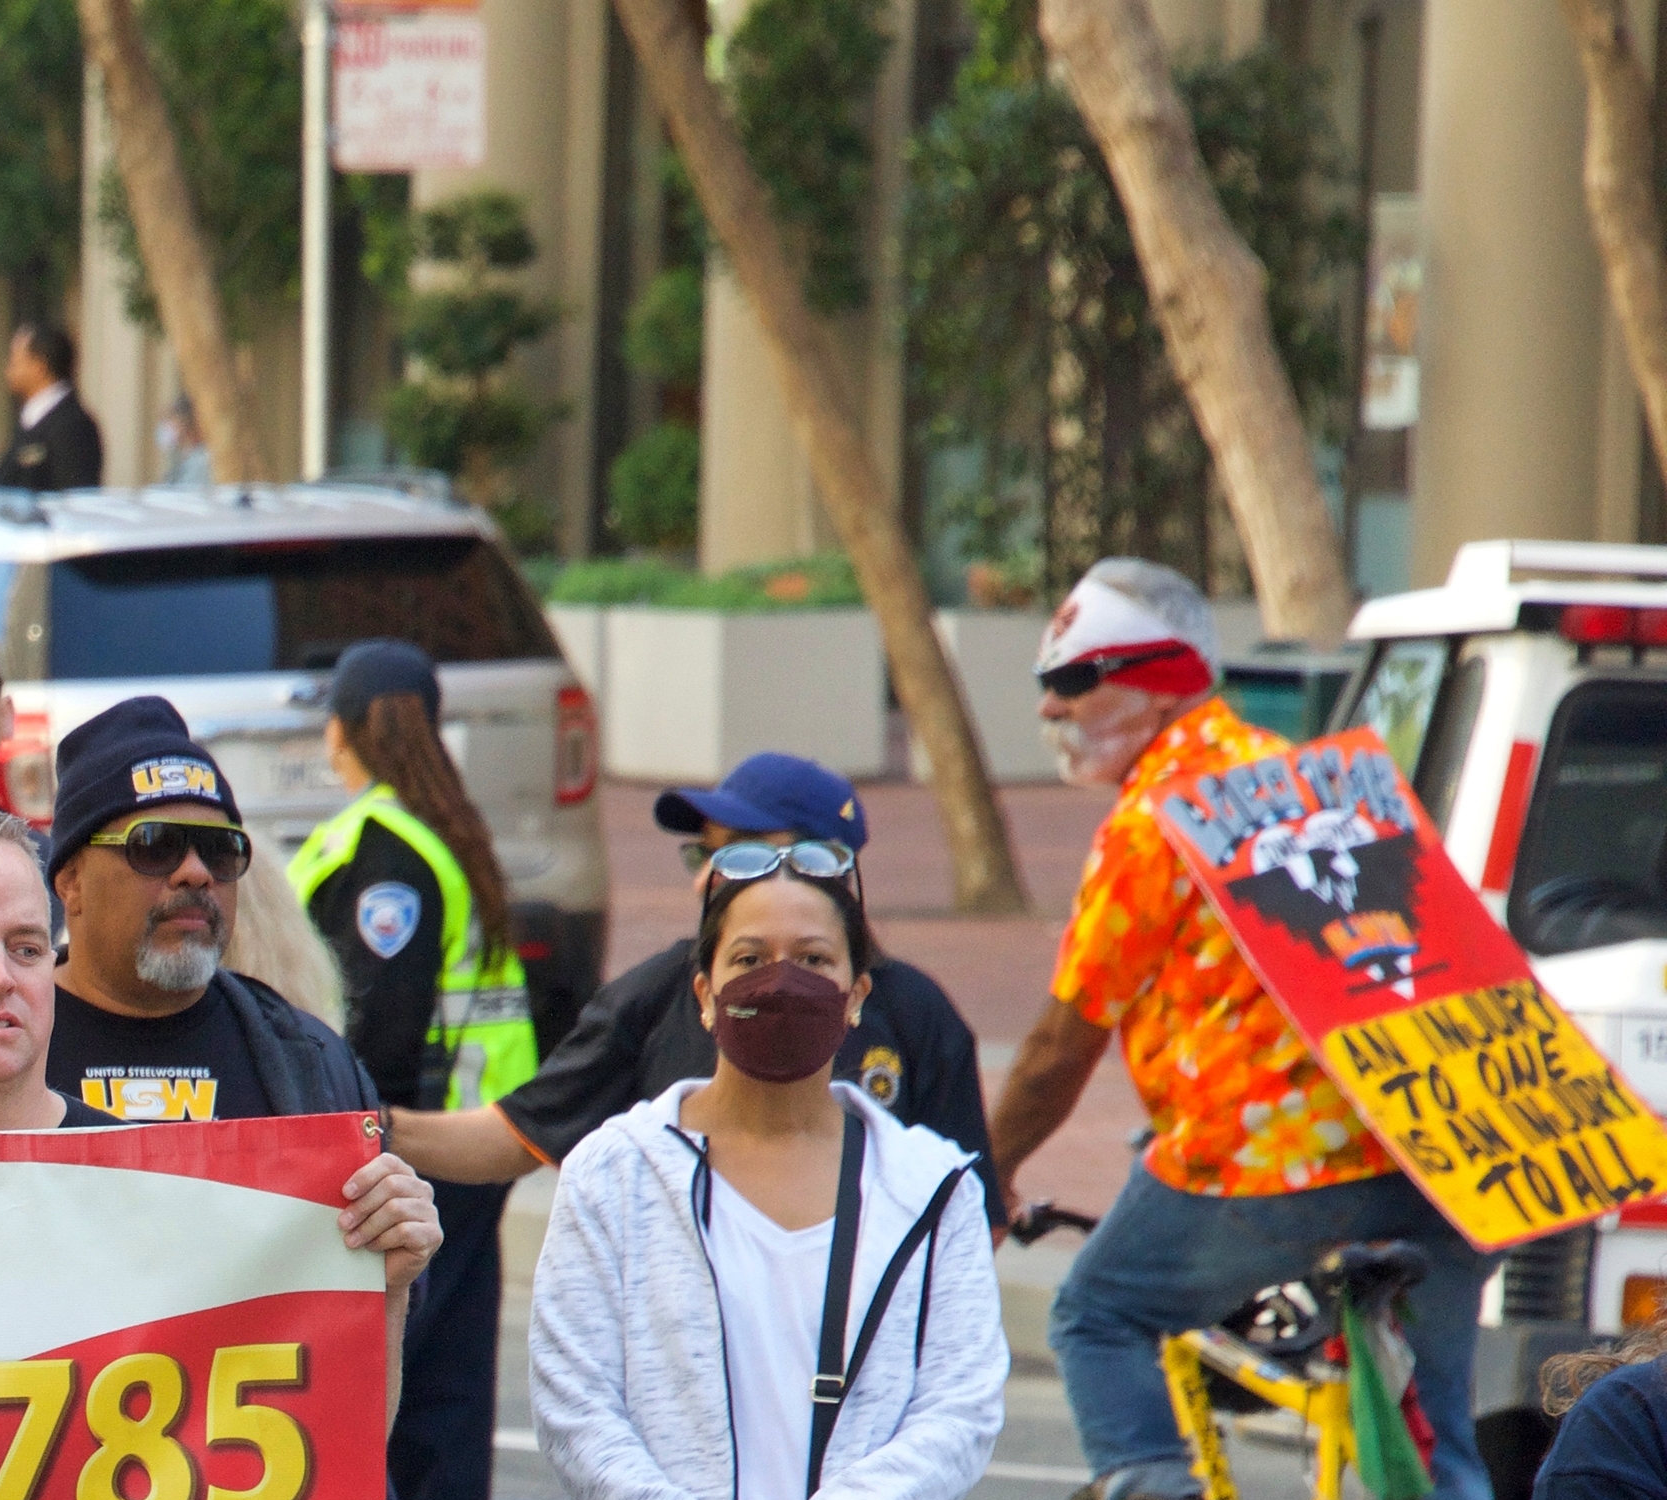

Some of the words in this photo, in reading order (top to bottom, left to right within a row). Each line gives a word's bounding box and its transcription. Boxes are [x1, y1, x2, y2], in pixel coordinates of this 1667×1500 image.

[132, 764, 217, 796] USW
[85, 1066, 126, 1079] UNITED
[127, 1066, 211, 1079] STEELWORKERS
[1339, 1023, 1409, 1079] AN
[1409, 979, 1559, 1056] INJURY
[80, 1078, 219, 1122] USW
[1380, 1064, 1461, 1122] TO
[1476, 1031, 1567, 1099] ONE
[1446, 1109, 1513, 1164] AN
[1500, 1066, 1638, 1147] INJURY
[1477, 1153, 1567, 1227] TO
[1555, 1133, 1657, 1212] ALL
